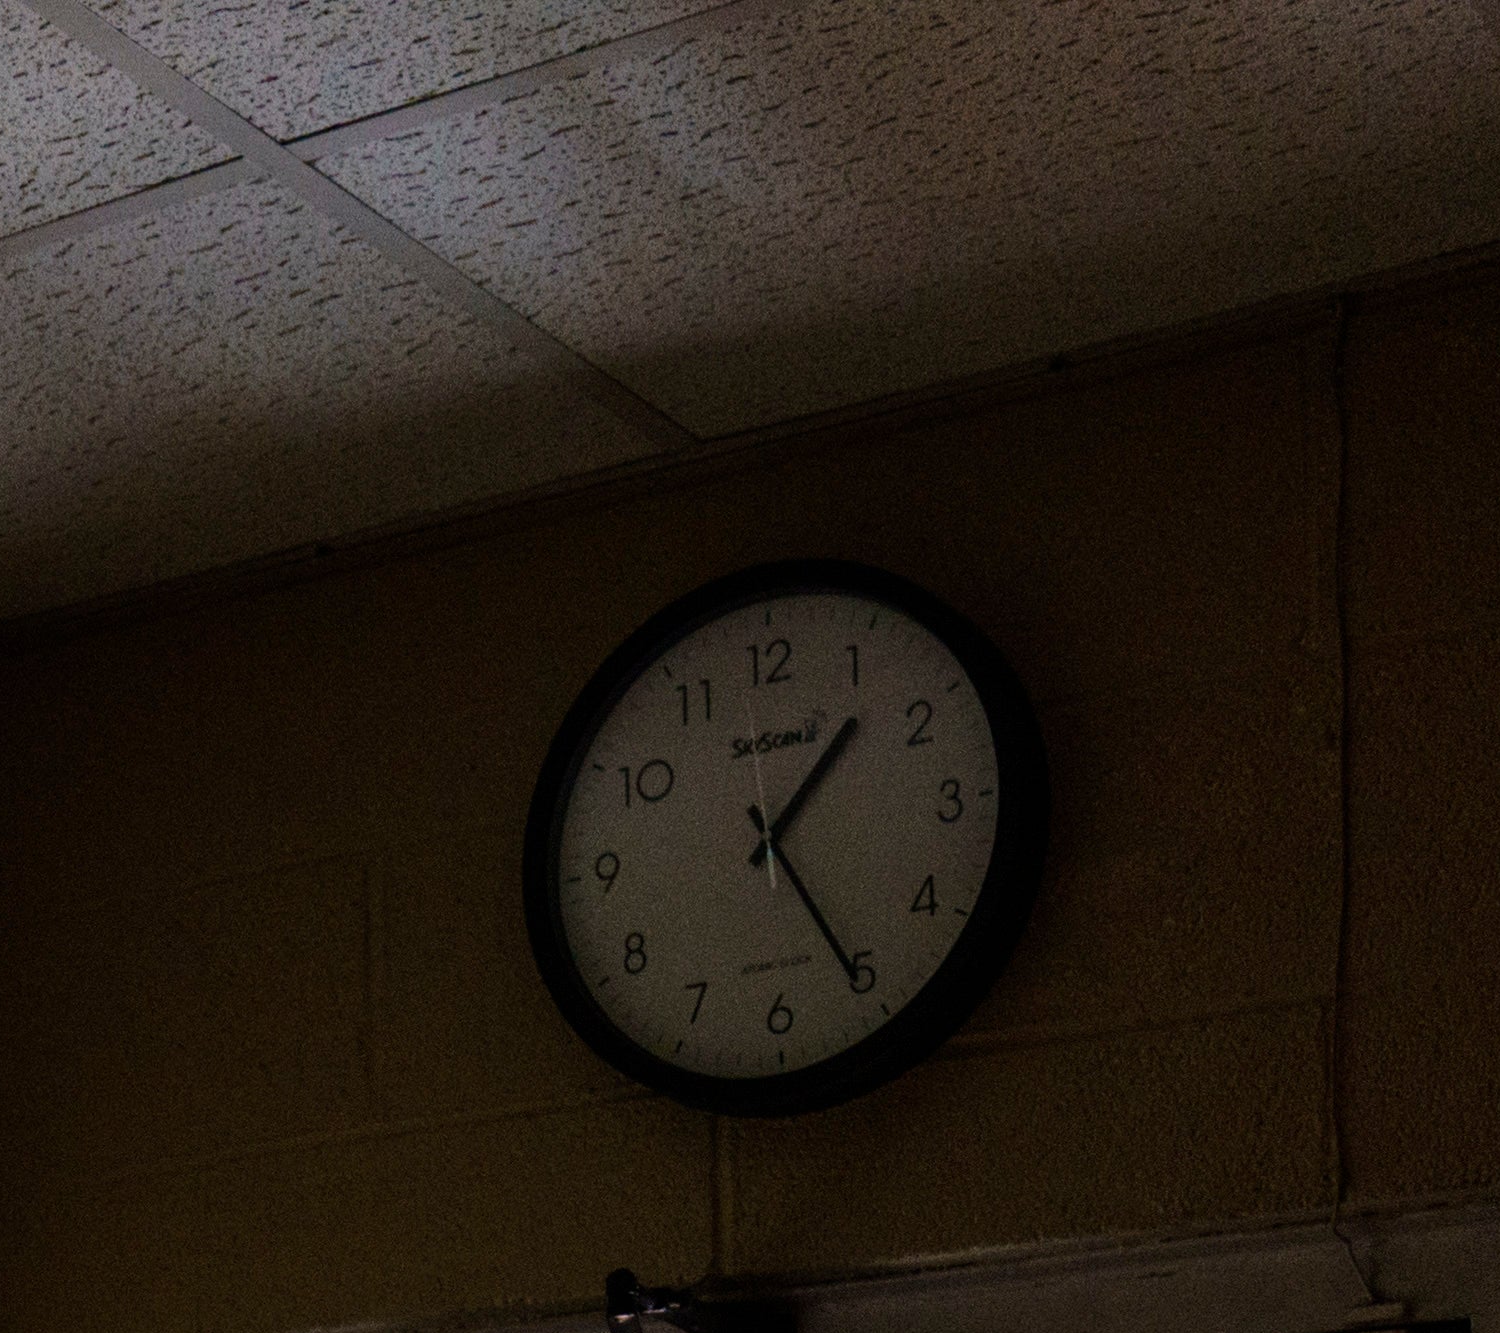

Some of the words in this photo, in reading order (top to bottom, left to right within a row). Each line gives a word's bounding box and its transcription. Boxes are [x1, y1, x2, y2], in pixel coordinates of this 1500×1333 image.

[746, 638, 793, 687] 12
[845, 644, 859, 687] 1
[676, 679, 712, 726] 11
[905, 699, 933, 747] 2
[619, 758, 674, 808] 10
[937, 778, 963, 823] 3
[596, 851, 620, 893] 9
[909, 874, 940, 916] 4
[623, 932, 647, 975] 8
[849, 950, 877, 994] 5
[685, 981, 708, 1025] 7
[766, 993, 794, 1035] 6
